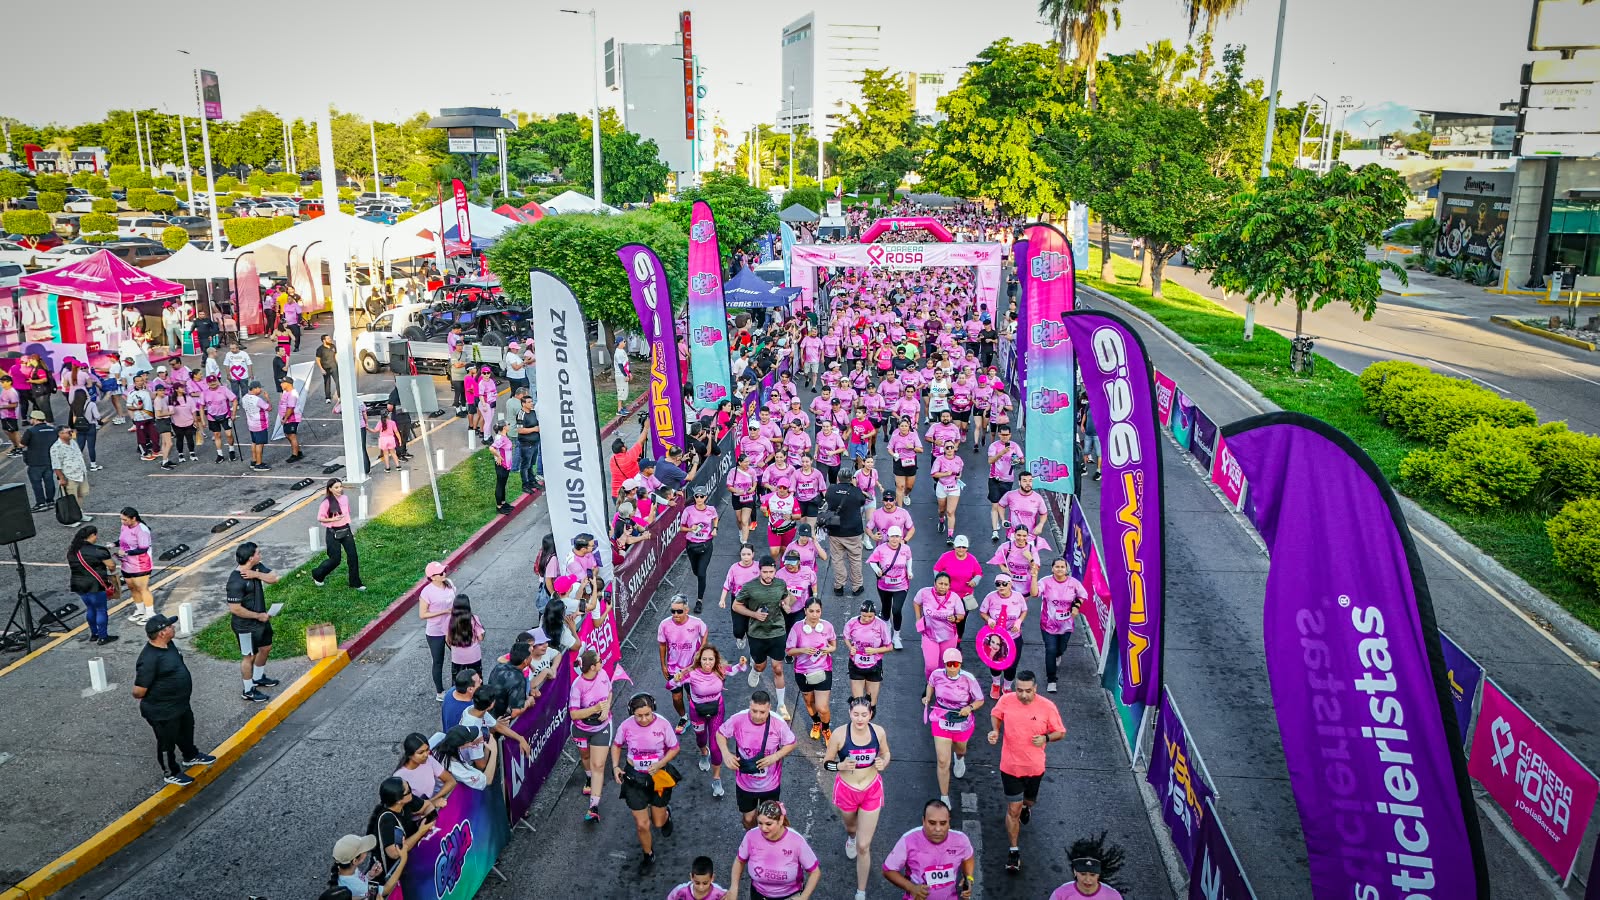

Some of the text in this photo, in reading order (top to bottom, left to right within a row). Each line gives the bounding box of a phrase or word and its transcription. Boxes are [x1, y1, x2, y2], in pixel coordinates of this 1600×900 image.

[885, 252, 923, 264] ROSA
[1032, 254, 1069, 276] Bella
[633, 250, 661, 337] 6.9
[549, 308, 568, 363] DÍAZ
[1032, 322, 1069, 344] Bella
[650, 341, 676, 459] VIBRA
[696, 383, 726, 400] Bella
[1032, 390, 1069, 410] Bella
[1091, 325, 1142, 468] 96.9
[557, 368, 583, 473] ALBERTO
[1030, 460, 1069, 478] Bella
[566, 478, 588, 525] LUIS
[628, 547, 656, 599] SINALOA
[1116, 470, 1151, 688] VIBRA
[855, 754, 870, 762] 606
[1518, 740, 1573, 806] CARRERA
[1515, 758, 1570, 835] ROSA
[764, 873, 788, 881] ROSA
[931, 870, 949, 880] 004
